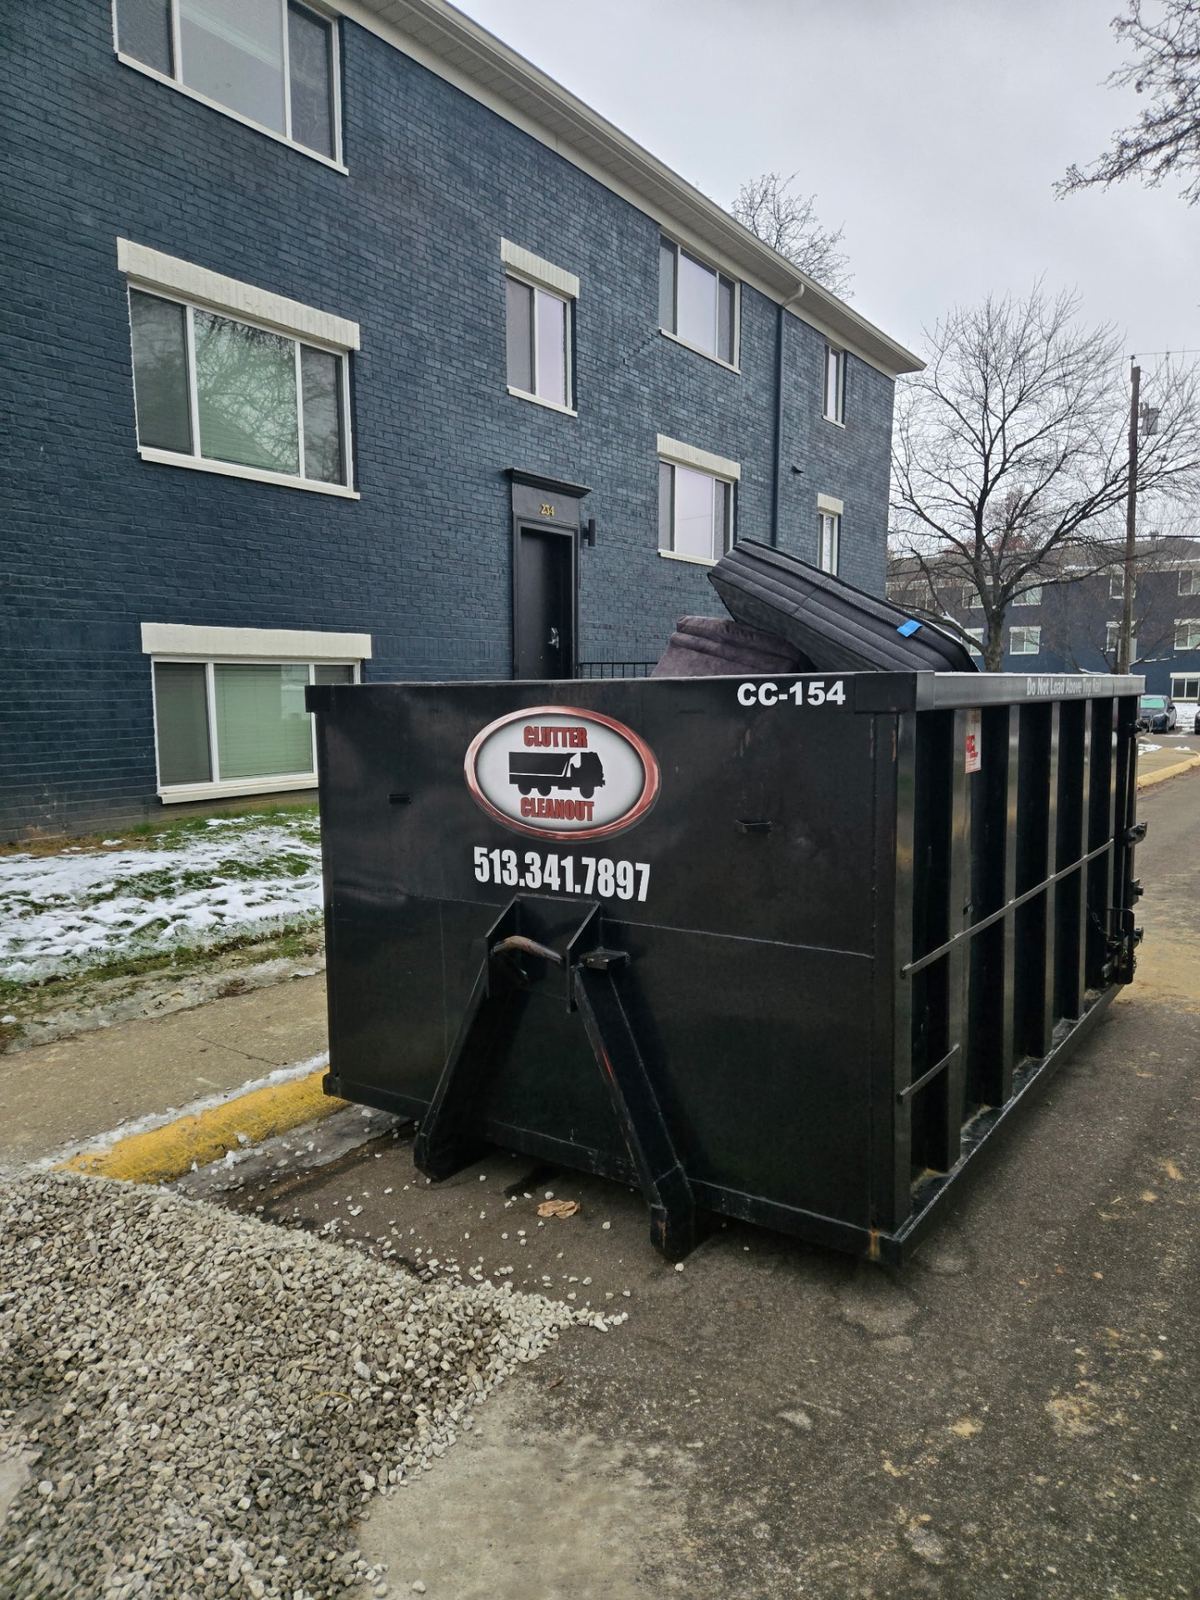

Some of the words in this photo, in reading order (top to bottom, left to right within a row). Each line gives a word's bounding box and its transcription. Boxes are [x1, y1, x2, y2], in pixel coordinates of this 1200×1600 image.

[737, 681, 846, 706] CC-154
[1026, 677, 1036, 696] Do
[1037, 677, 1049, 695] Not
[1050, 677, 1065, 695] Load
[1065, 678, 1082, 694] Above
[523, 725, 588, 748] CLUTTER
[520, 797, 594, 821] CLEANOUT
[473, 846, 650, 902] 513.341.7897
